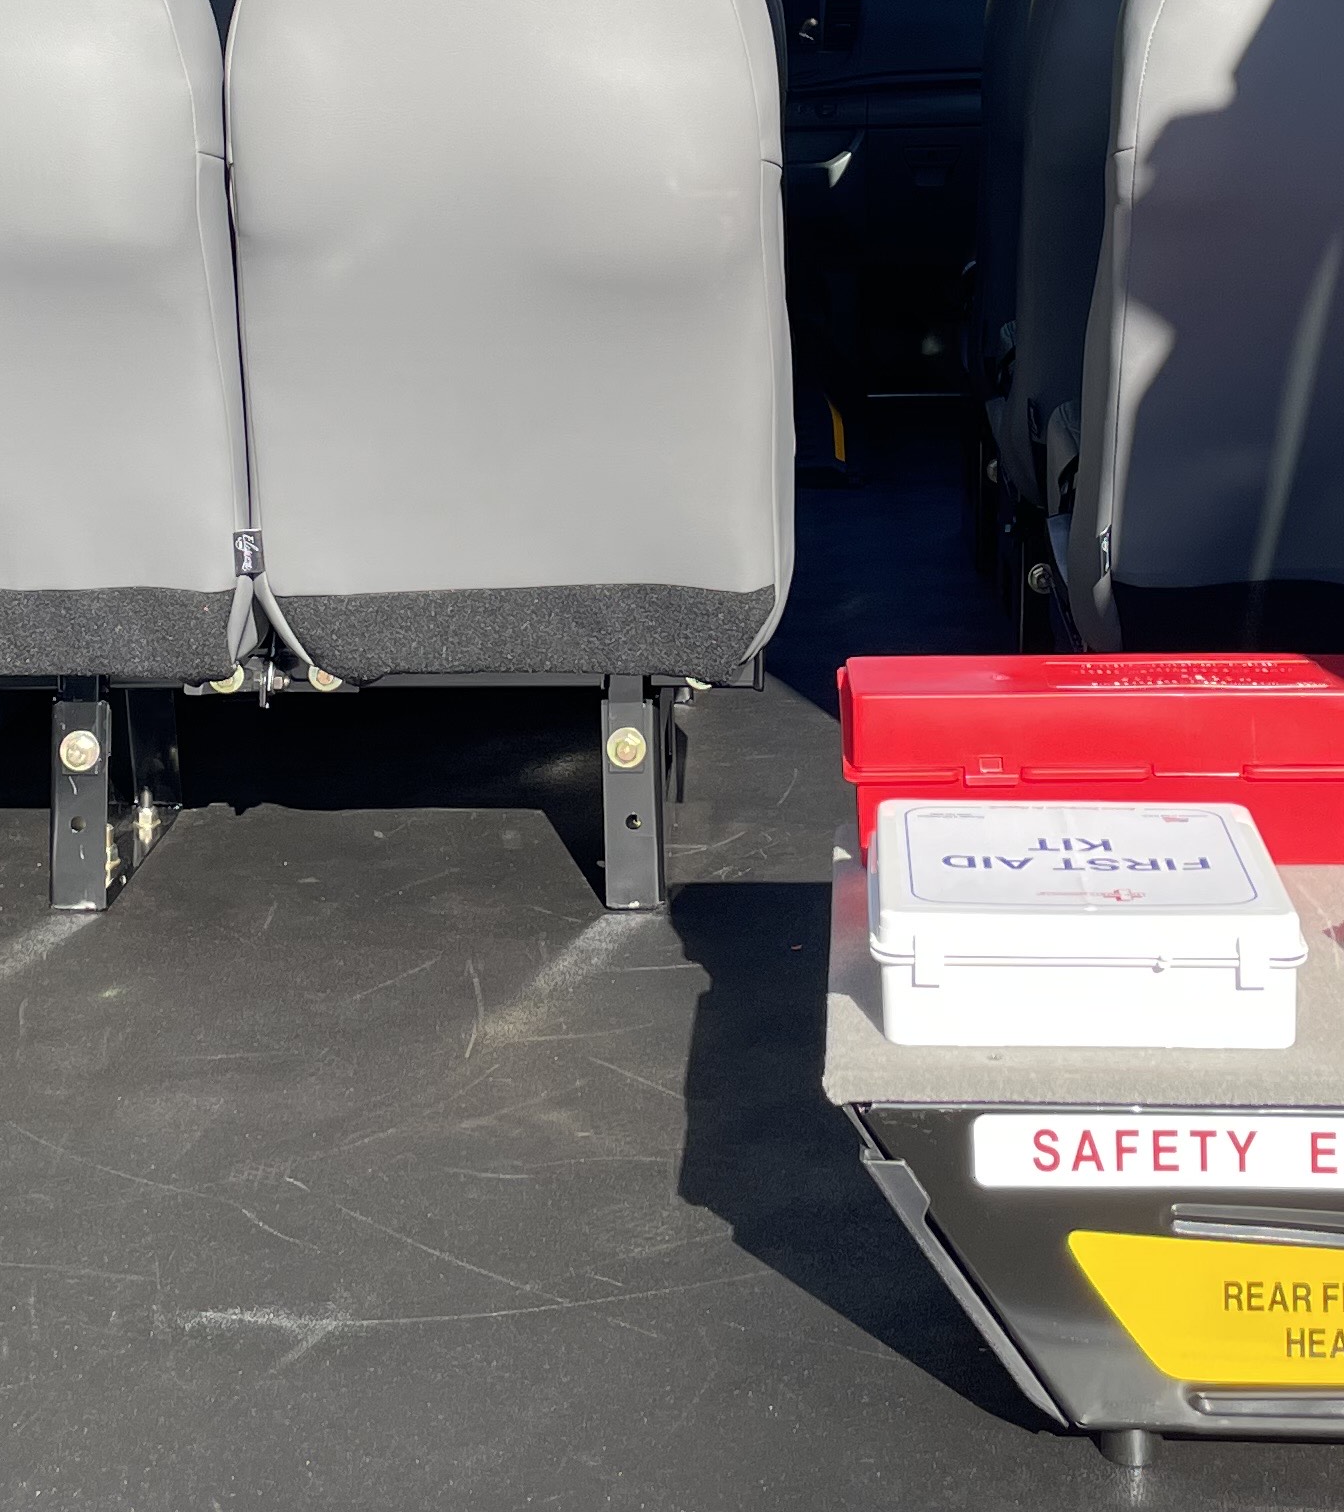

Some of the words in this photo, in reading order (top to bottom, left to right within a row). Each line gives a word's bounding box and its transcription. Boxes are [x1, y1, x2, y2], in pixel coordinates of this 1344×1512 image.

[1027, 837, 1114, 852] KIT
[941, 854, 1034, 871] AID
[1053, 856, 1212, 871] FIRST
[1032, 1128, 1257, 1173] SAFETY
[1223, 1282, 1312, 1313] REAR
